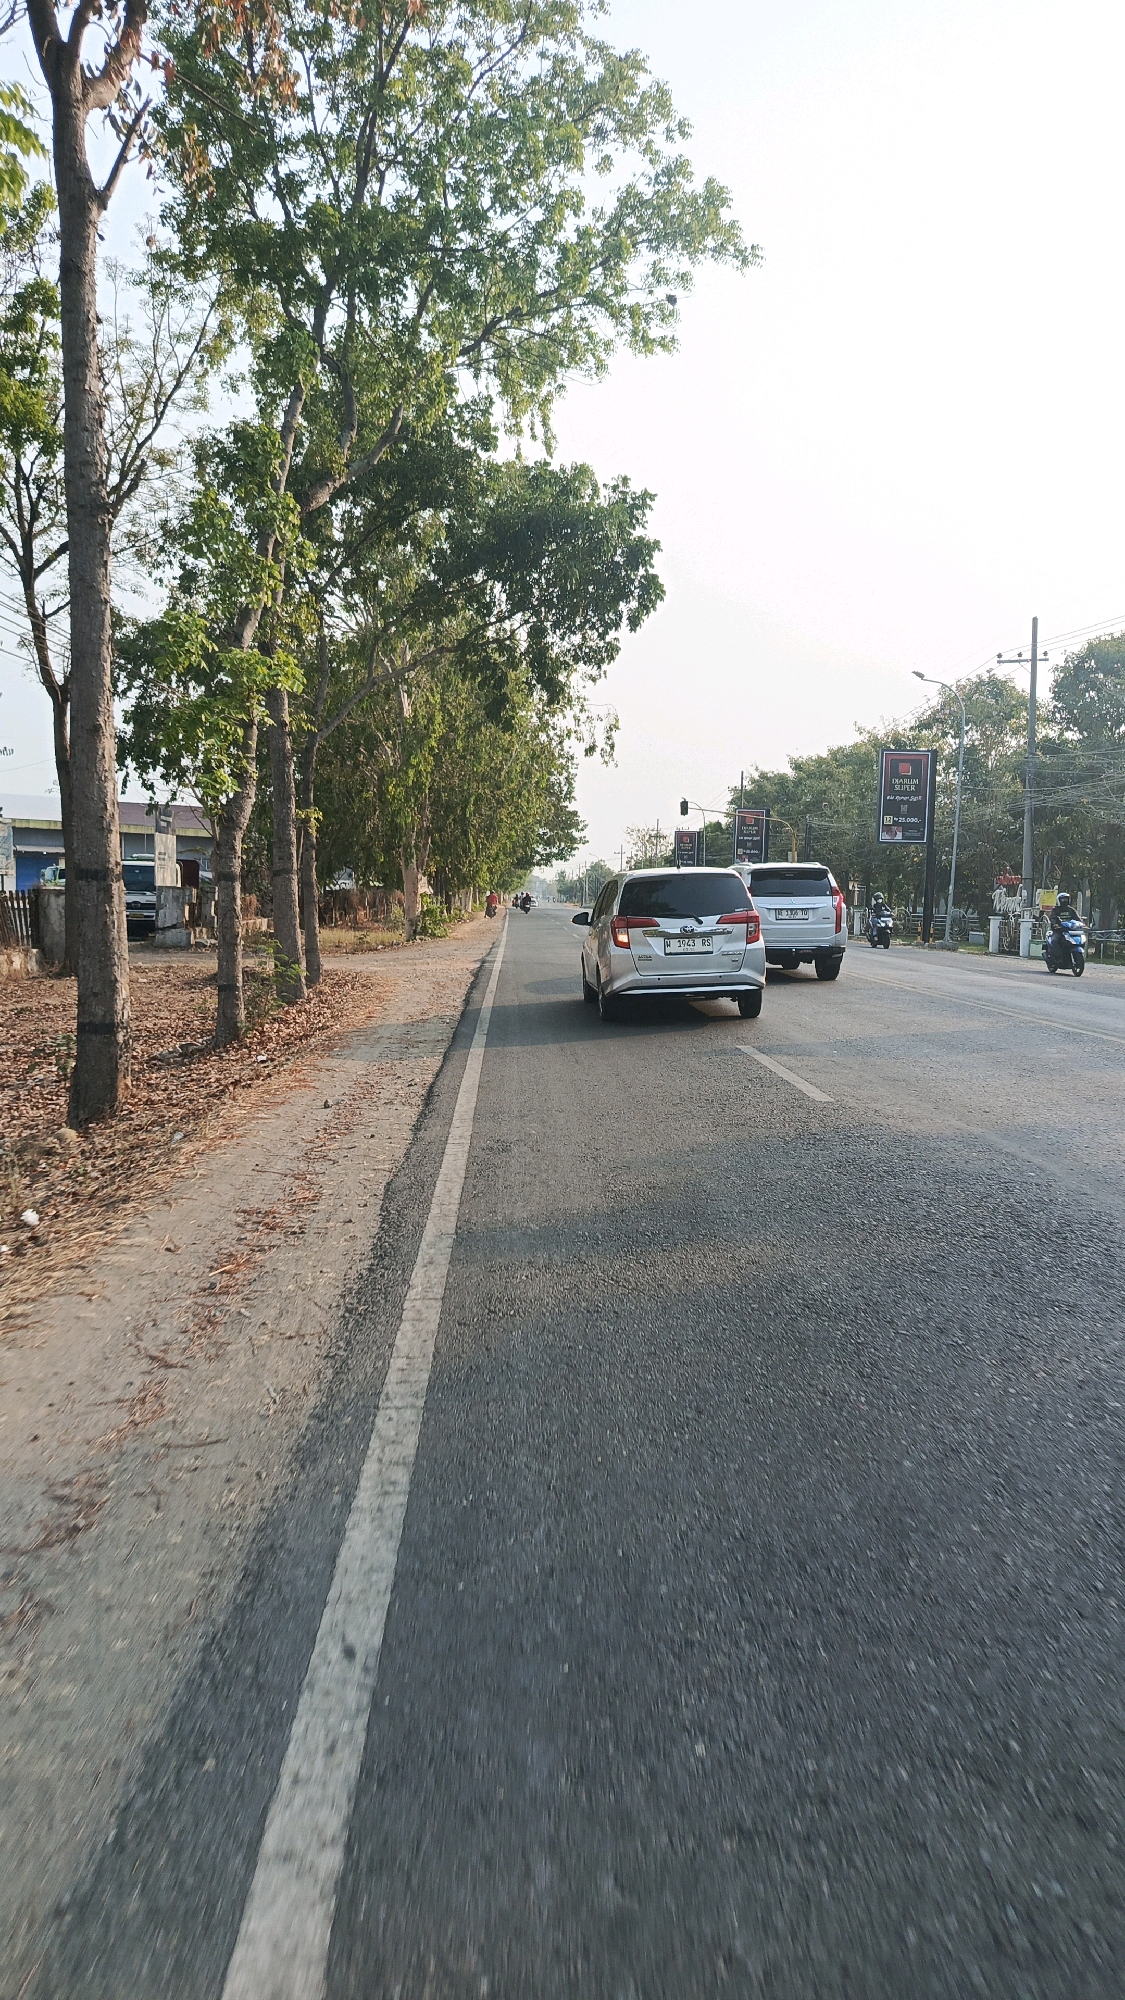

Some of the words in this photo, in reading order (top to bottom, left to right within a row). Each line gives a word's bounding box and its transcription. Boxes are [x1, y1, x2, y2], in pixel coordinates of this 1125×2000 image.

[665, 940, 671, 948] W
[677, 939, 696, 948] 1943
[701, 938, 711, 947] RS
